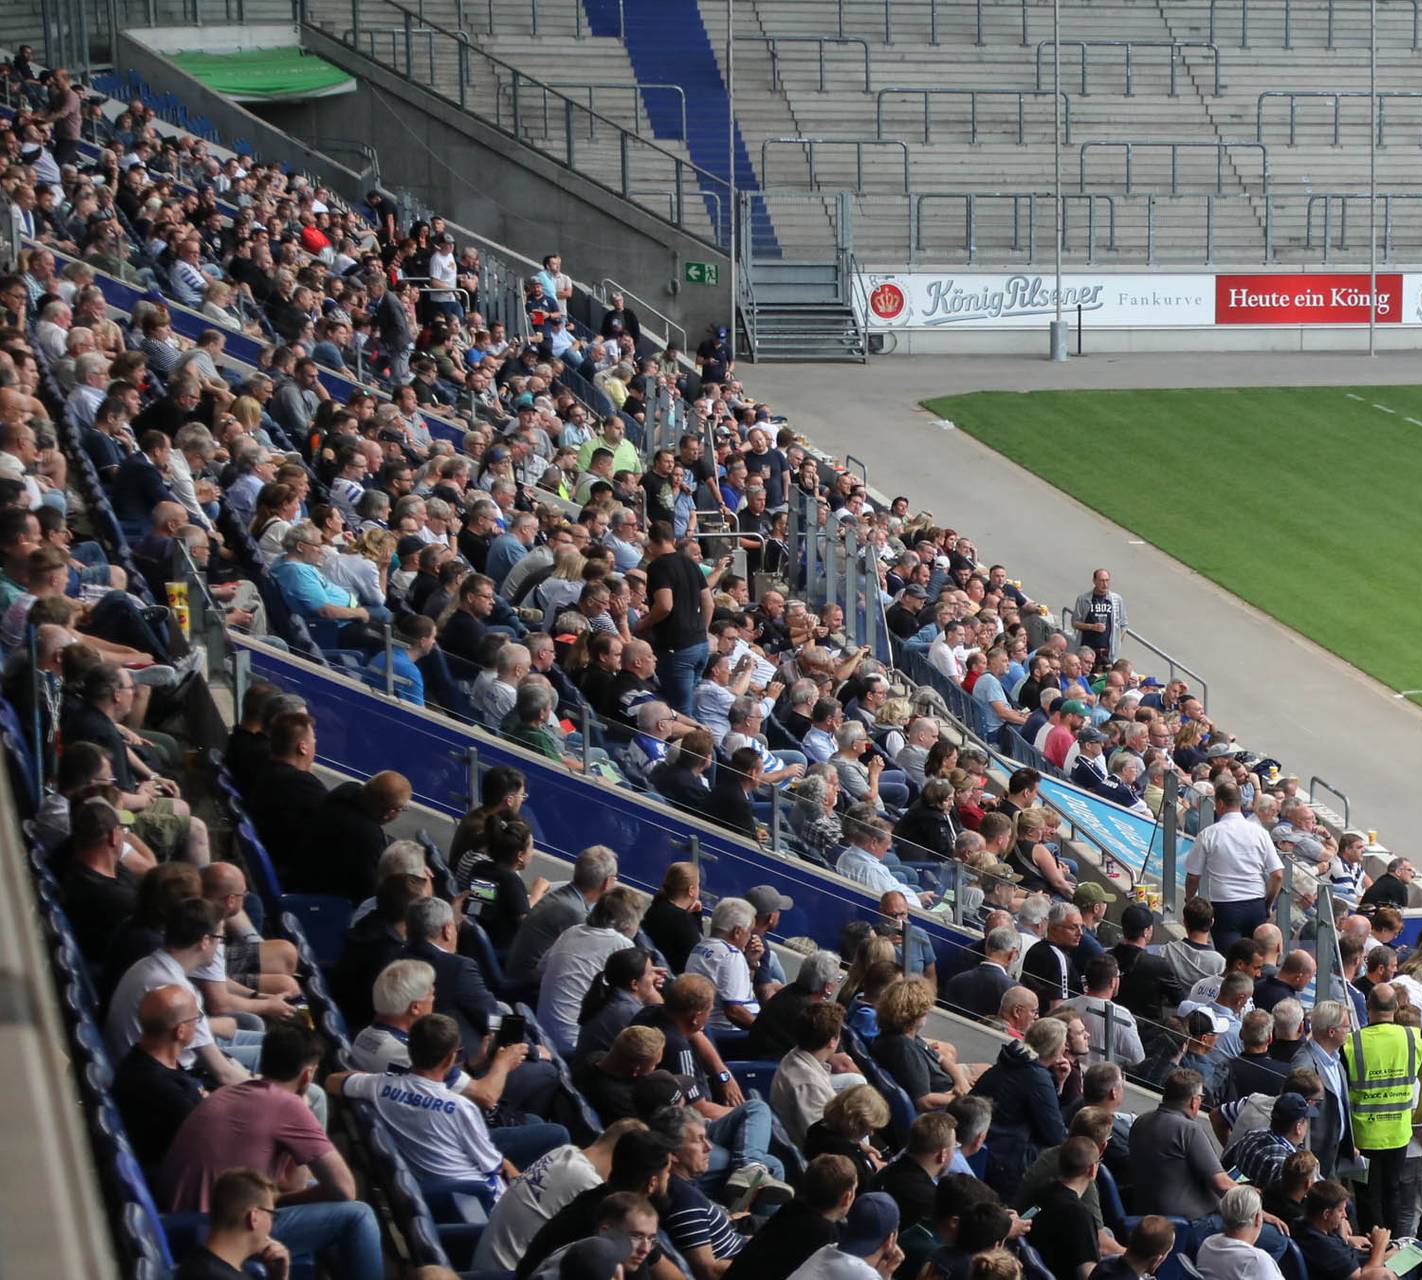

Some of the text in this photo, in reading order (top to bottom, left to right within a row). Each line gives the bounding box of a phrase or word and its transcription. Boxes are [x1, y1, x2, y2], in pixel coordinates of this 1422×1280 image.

[922, 276, 1104, 318] König Pilsener
[1118, 291, 1202, 306] Fankurve
[1229, 288, 1390, 315] Heute ein König
[1090, 603, 1112, 613] 1902
[382, 1085, 456, 1114] DUISBURG
